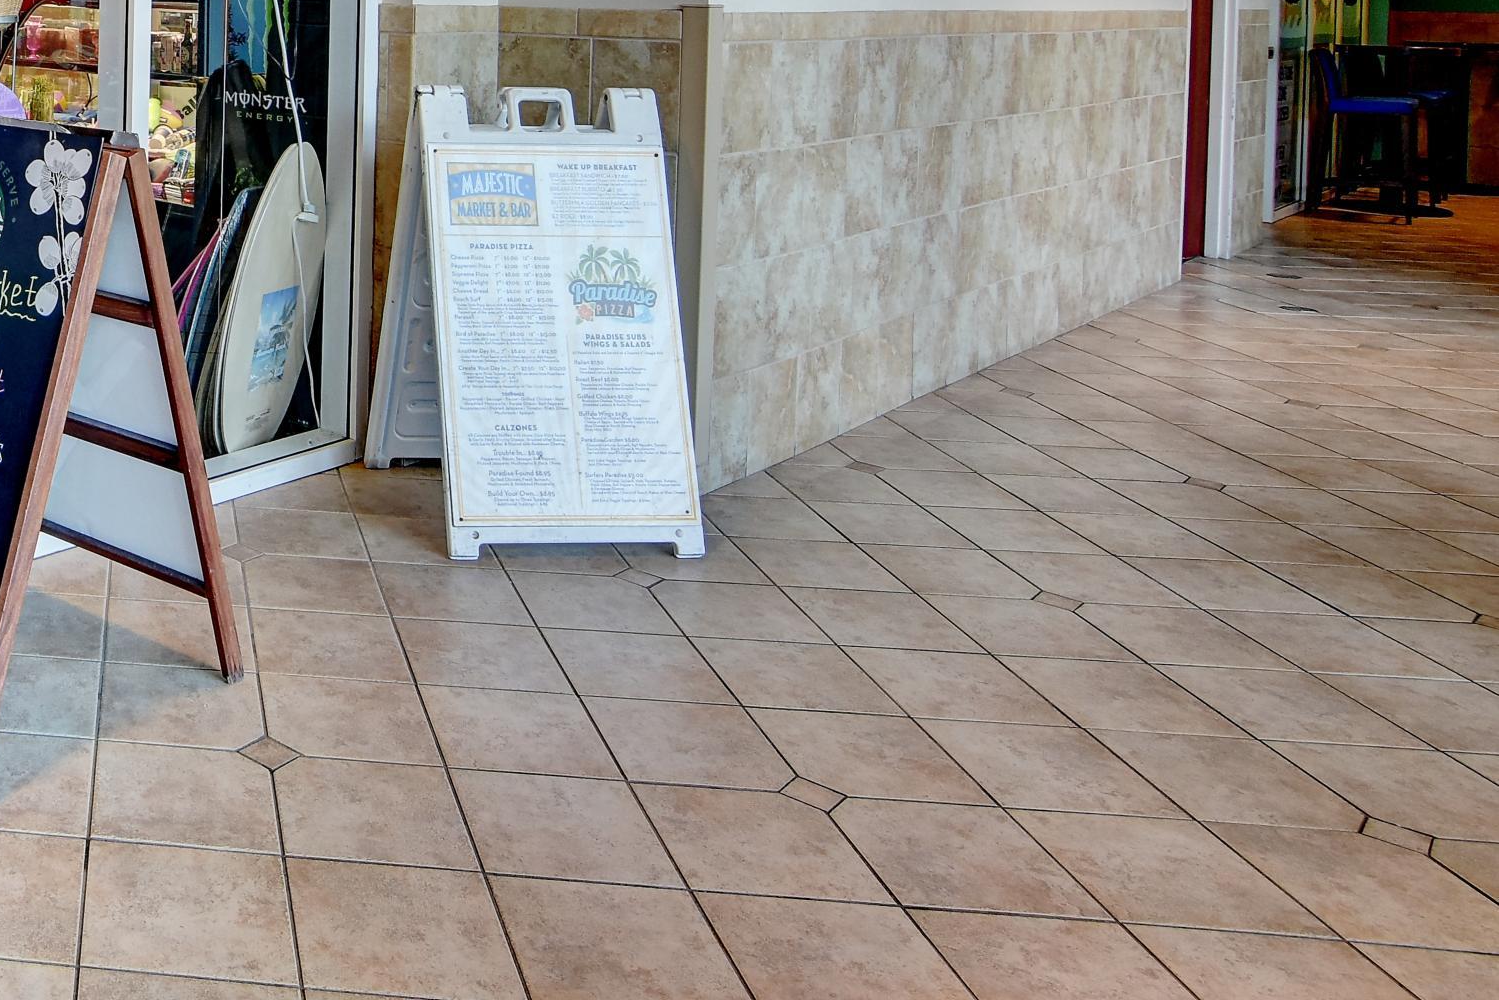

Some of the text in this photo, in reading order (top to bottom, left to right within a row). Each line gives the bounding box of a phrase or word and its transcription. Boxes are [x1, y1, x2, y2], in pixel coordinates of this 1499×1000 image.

[236, 110, 295, 123] ENERGY
[461, 172, 524, 196] MAJESTIC
[457, 202, 531, 218] MARKET & BAR
[571, 281, 655, 305] Paradise
[596, 304, 633, 316] PIZZA
